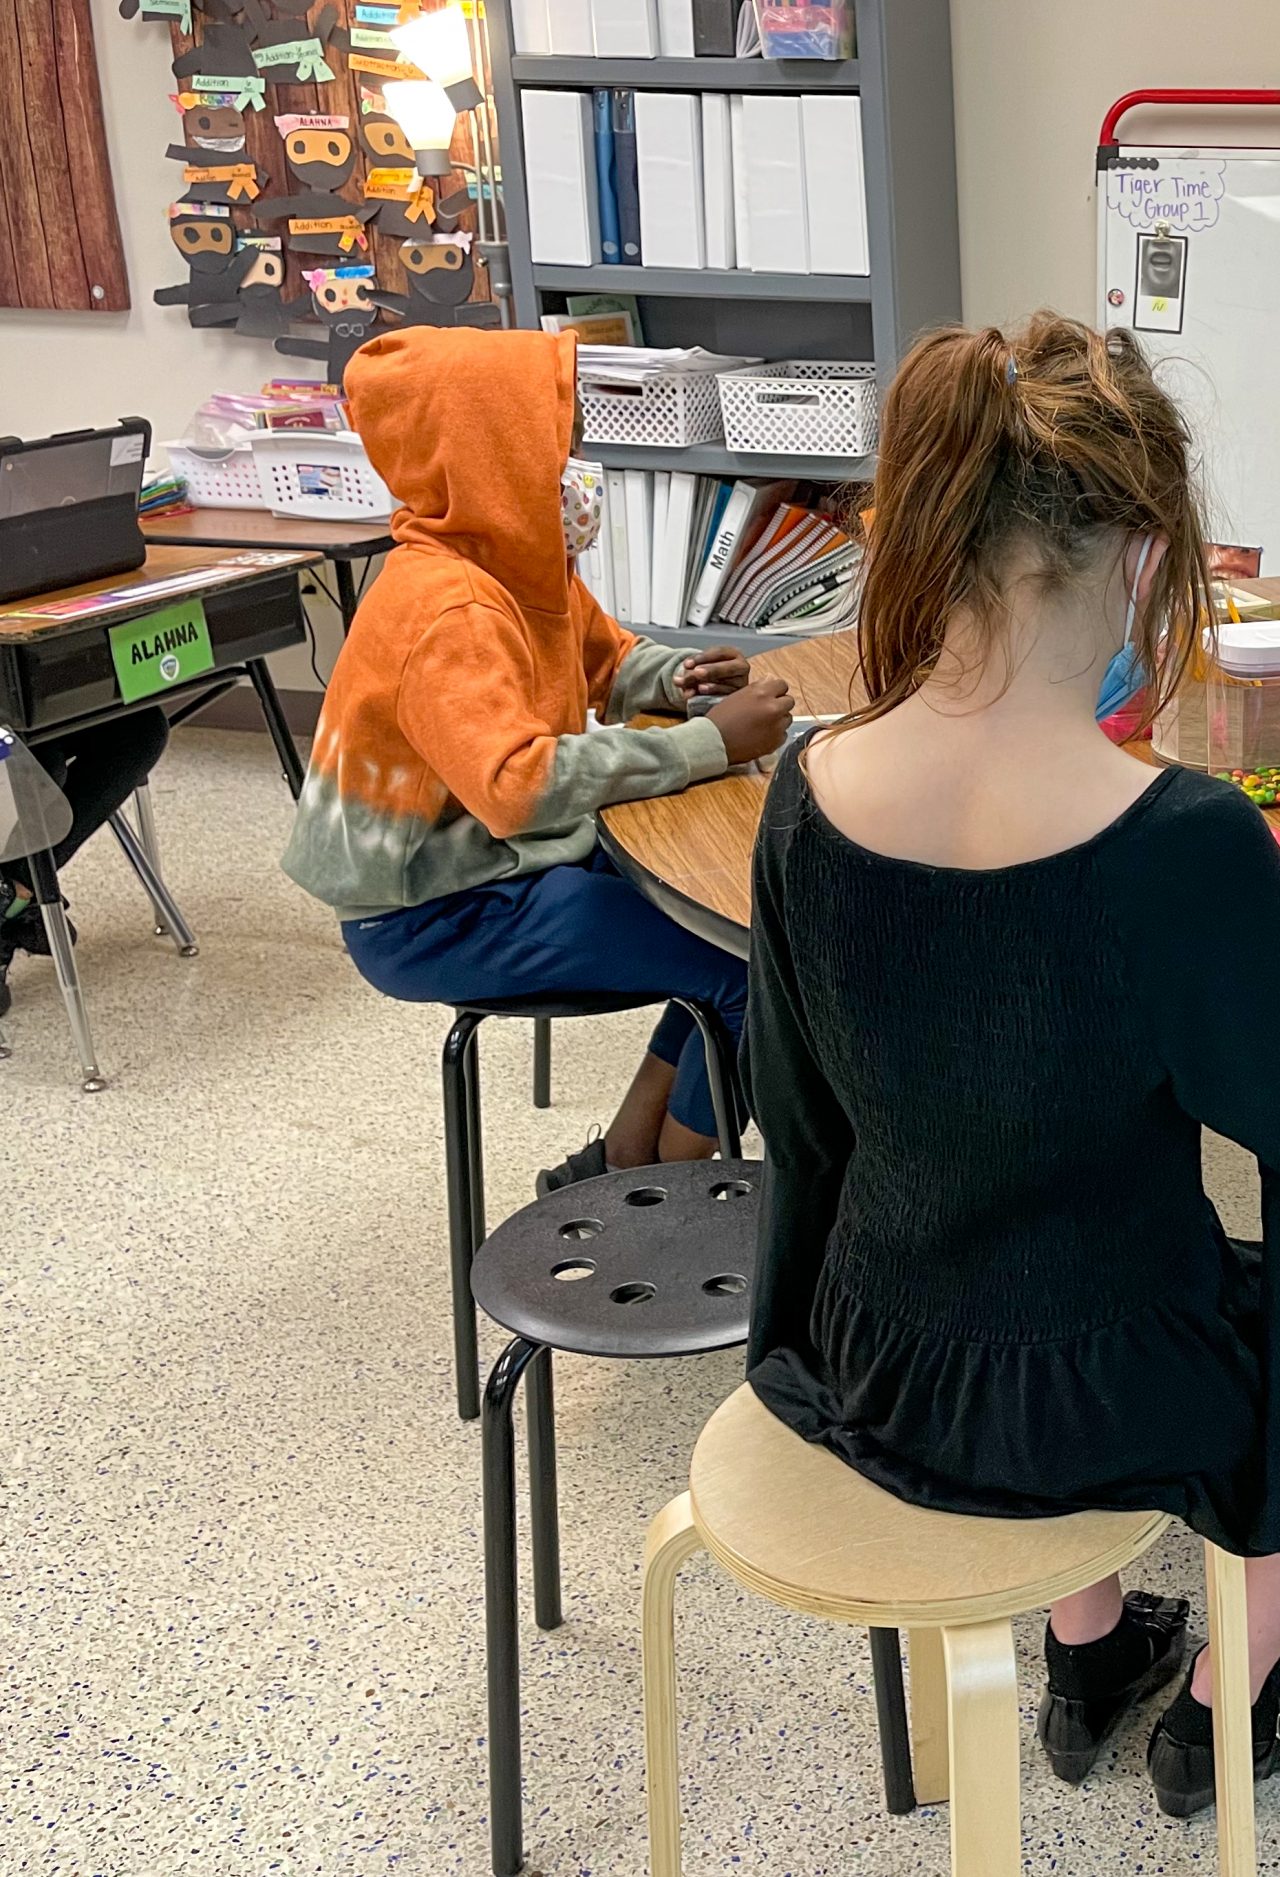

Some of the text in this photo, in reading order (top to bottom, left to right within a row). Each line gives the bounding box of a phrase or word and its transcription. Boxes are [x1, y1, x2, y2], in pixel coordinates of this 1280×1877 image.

[195, 77, 229, 88] Addition
[299, 117, 332, 127] ALAHNA
[1115, 173, 1211, 207] Tiger Time
[1144, 198, 1210, 221] Group 1
[294, 221, 332, 231] Addition
[710, 531, 735, 570] Math
[132, 622, 198, 665] ALAHNA
